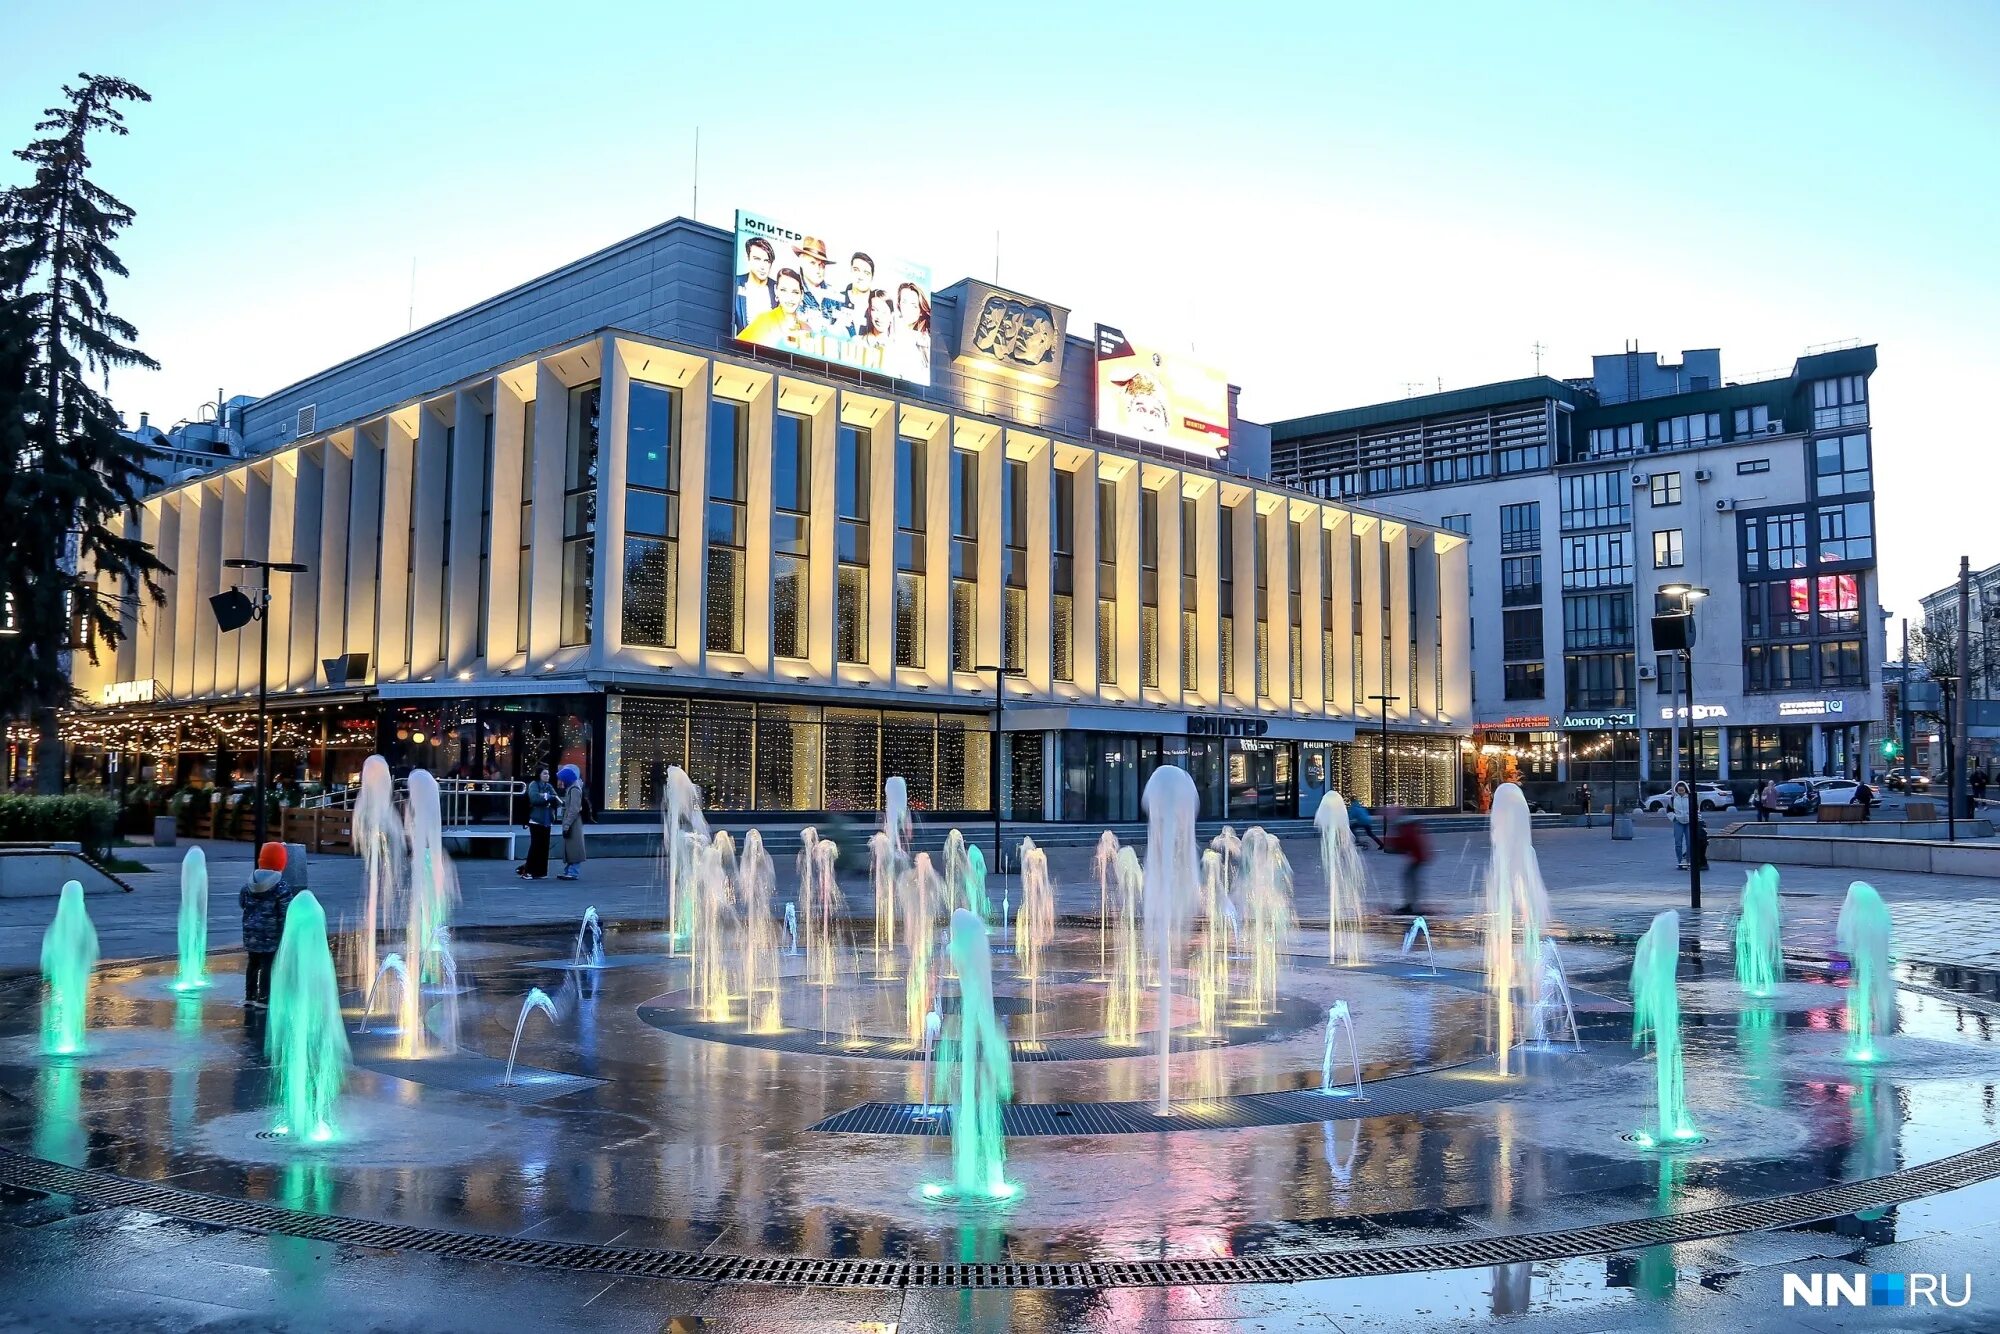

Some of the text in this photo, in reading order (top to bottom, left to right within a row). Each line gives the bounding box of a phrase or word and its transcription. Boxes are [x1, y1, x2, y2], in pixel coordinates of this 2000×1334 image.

[745, 217, 803, 241] ЮПИТЕР
[1187, 716, 1269, 737] ЮПИТЕР
[1563, 717, 1604, 729] Доктор
